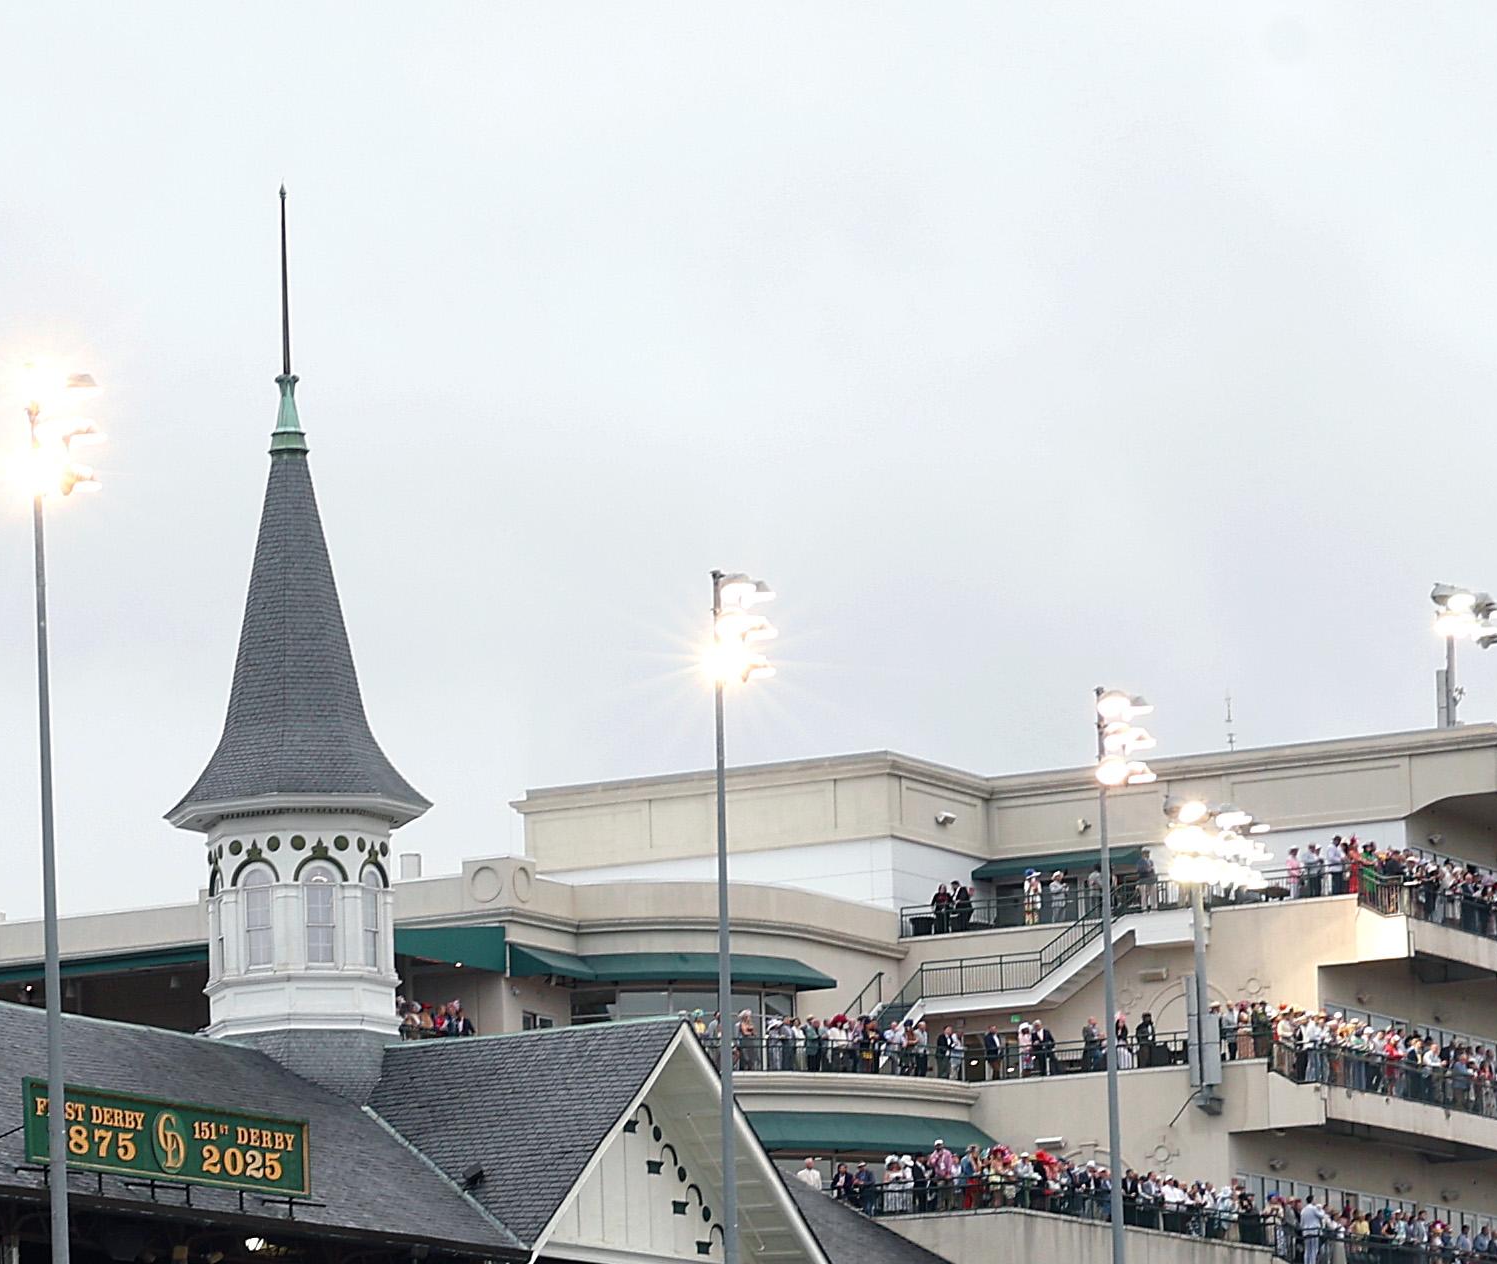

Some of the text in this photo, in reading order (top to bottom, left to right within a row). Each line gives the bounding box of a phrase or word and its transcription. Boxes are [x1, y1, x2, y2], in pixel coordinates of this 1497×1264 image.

[36, 1096, 145, 1130] FST DERBY
[69, 1125, 137, 1162] 875
[237, 1127, 295, 1151] DERBY
[201, 1144, 283, 1181] 2025
